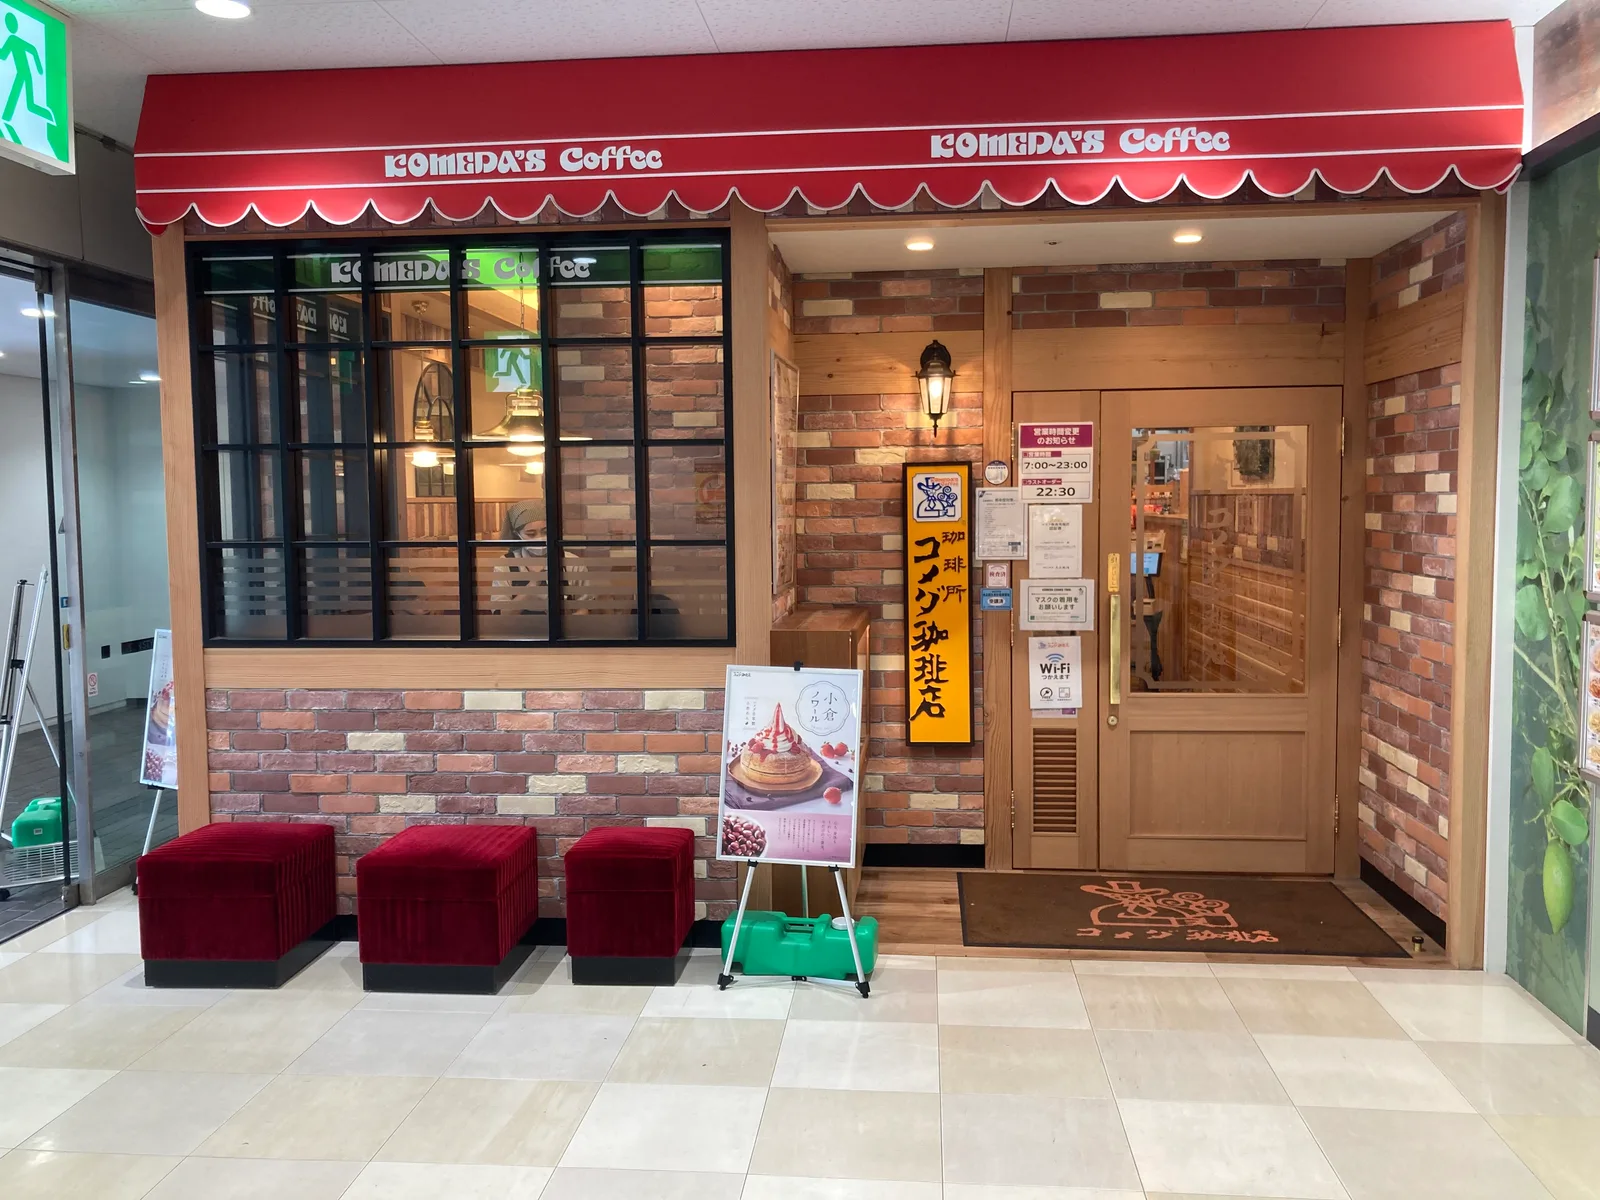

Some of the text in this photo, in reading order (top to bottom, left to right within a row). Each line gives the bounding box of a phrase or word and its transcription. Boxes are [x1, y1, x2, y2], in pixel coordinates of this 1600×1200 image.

[930, 126, 1231, 158] KOMEDA'S Coffee
[385, 145, 663, 178] KOMEDA'S Coffee
[1037, 436, 1076, 445] のお知らせ
[1036, 487, 1076, 497] 22:30
[941, 530, 967, 603] 珈琲所
[909, 536, 949, 721] コメダ珈琲店
[1040, 663, 1071, 674] Wi-Fi
[810, 691, 820, 723] ノワール
[822, 692, 838, 722] 小倉
